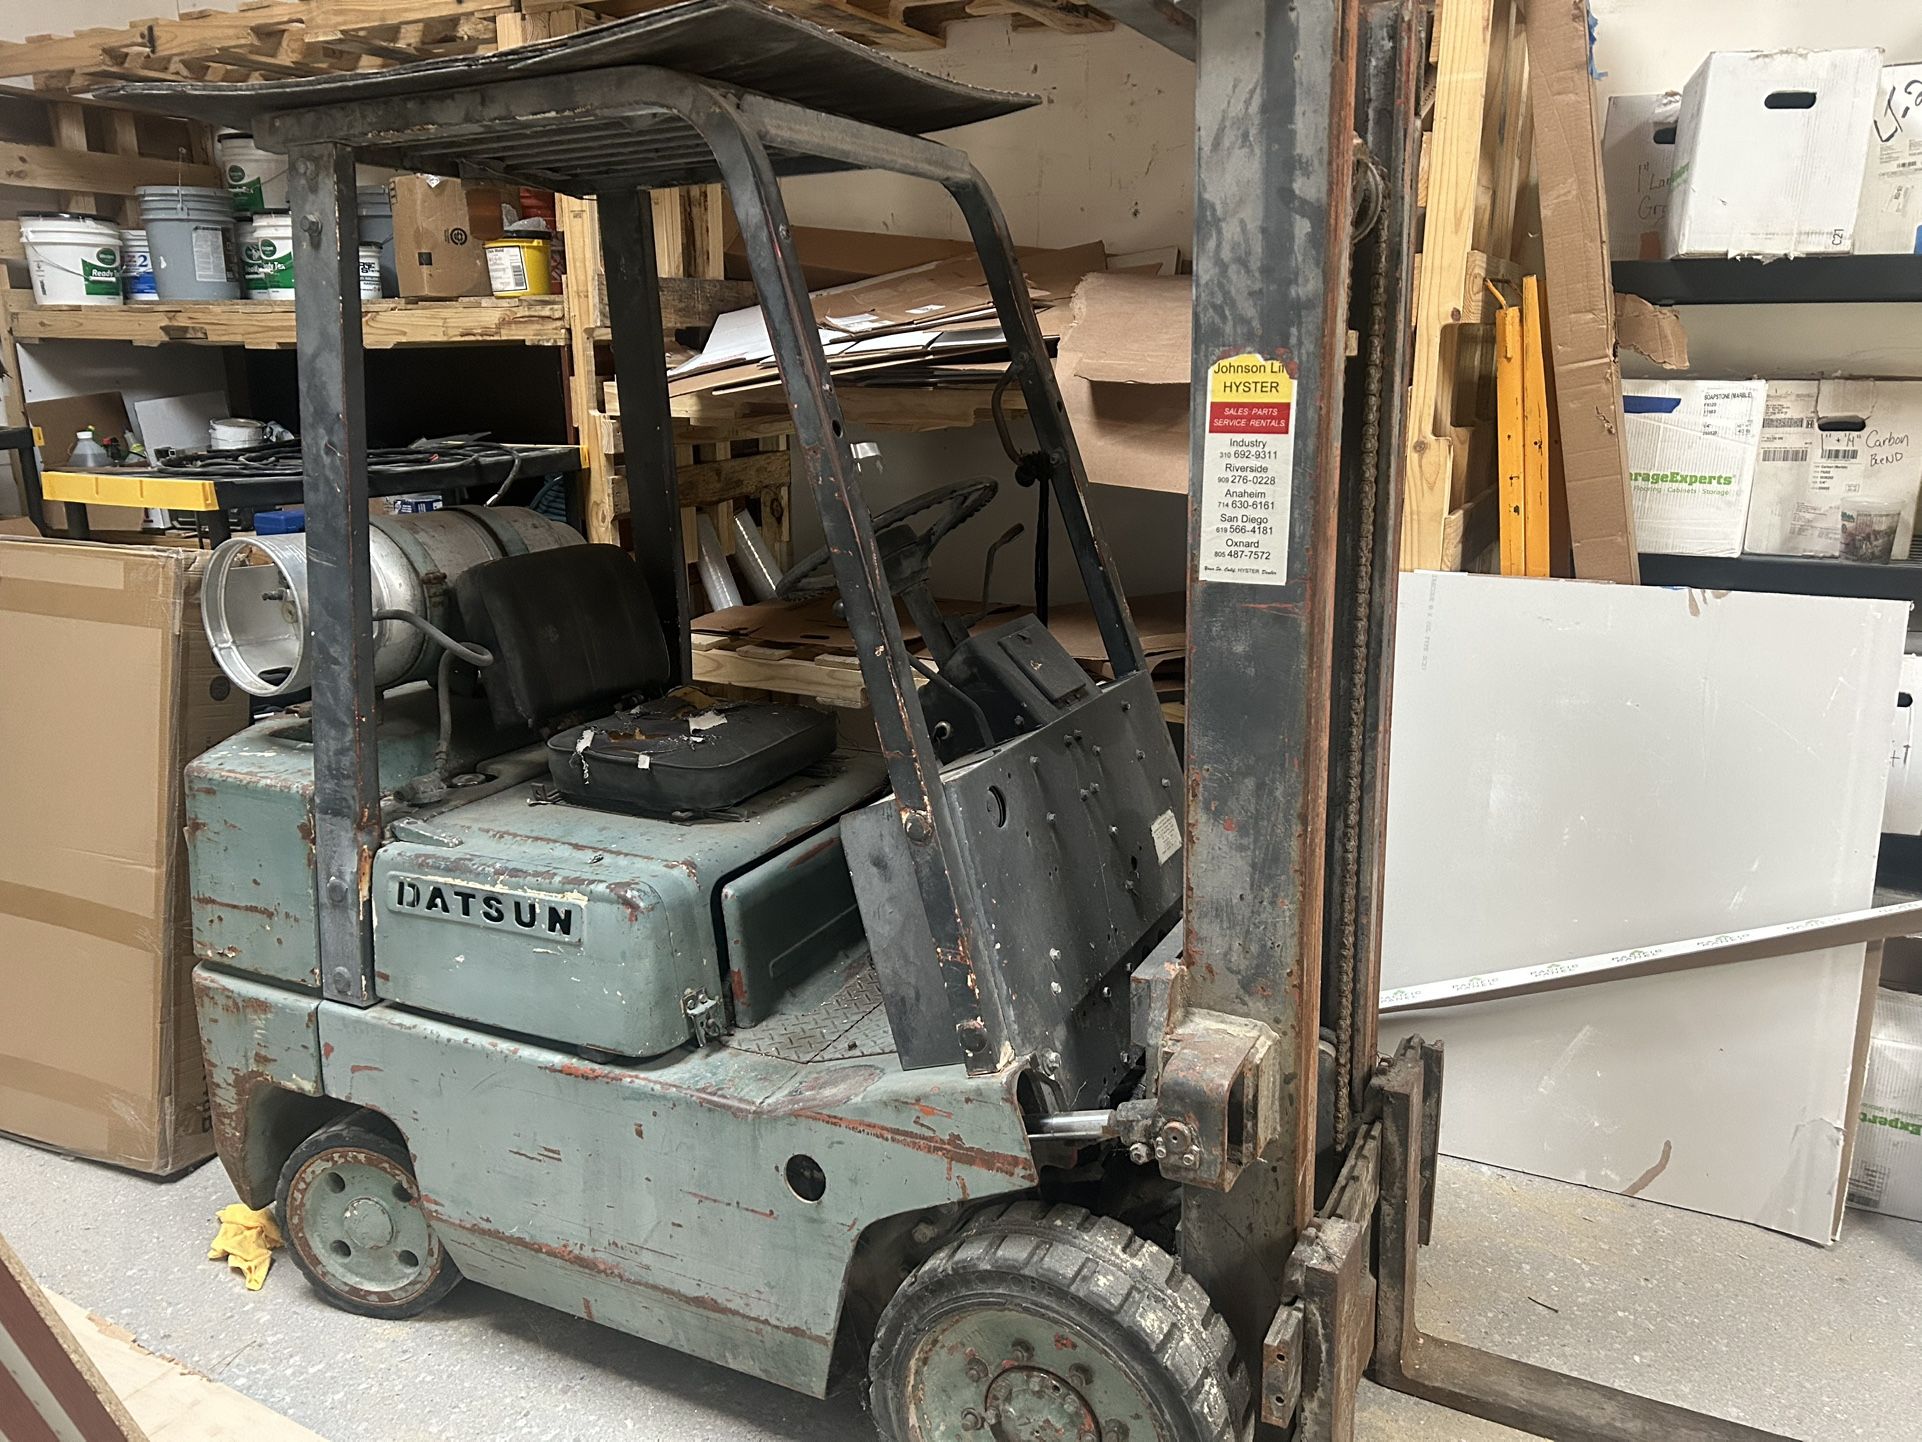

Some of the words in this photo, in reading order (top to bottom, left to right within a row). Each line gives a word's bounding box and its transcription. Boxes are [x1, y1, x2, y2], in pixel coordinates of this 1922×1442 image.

[1832, 228, 1845, 246] C21
[1213, 362, 1266, 374] Johnson
[1223, 381, 1280, 393] HYSTER
[1229, 438, 1267, 450] Industry
[1865, 429, 1909, 449] Carbon
[1233, 449, 1278, 460] 692-9311
[1225, 463, 1269, 474] Riverside
[1230, 474, 1276, 485] 276-0228
[1224, 488, 1266, 499] Anaheim
[1231, 499, 1275, 510] 630-6161
[1220, 513, 1238, 523] San
[1241, 514, 1268, 525] Diego
[1215, 526, 1228, 534] 619
[1229, 525, 1273, 535] 566-4181
[1225, 538, 1260, 549] Oxnard
[1227, 549, 1271, 560] 487-7572
[396, 880, 572, 936] DATSUN
